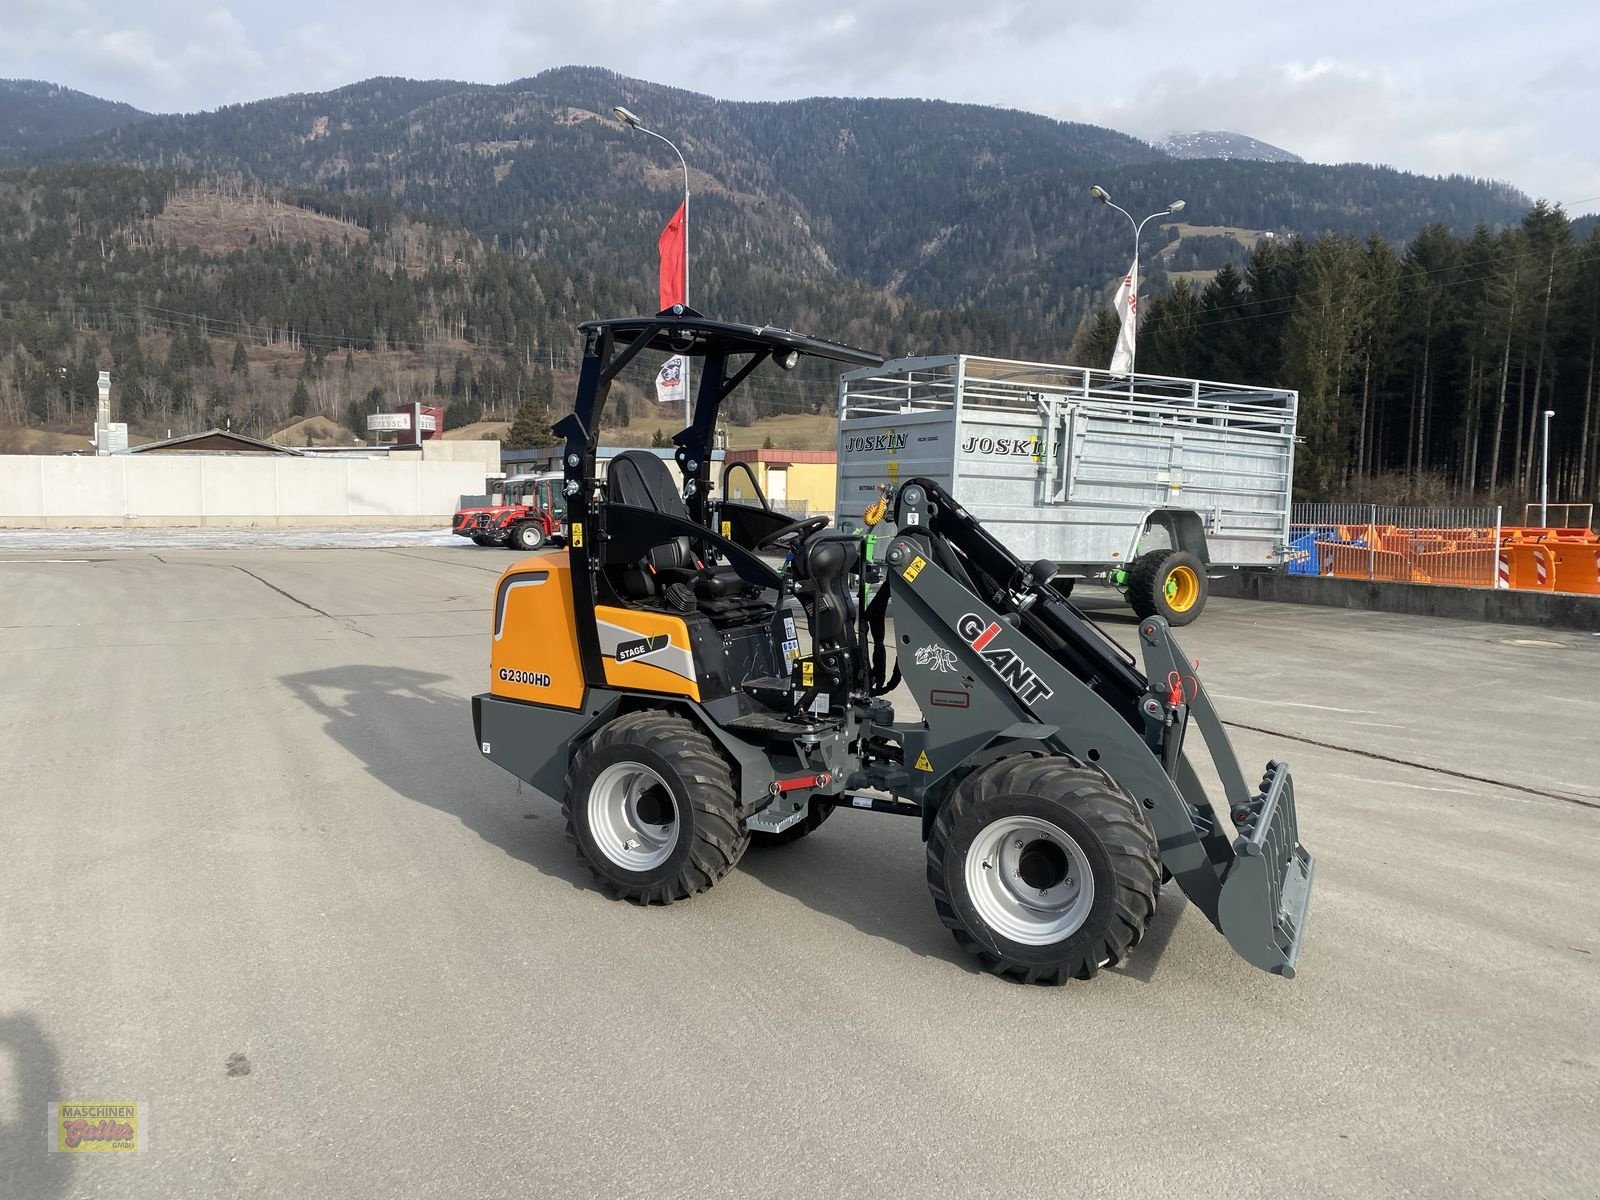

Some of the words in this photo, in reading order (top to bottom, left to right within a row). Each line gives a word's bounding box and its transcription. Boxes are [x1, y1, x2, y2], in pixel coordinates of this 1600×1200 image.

[845, 432, 908, 452] JOSKIN
[620, 645, 646, 659] STAGE
[957, 613, 1054, 706] GIANT
[498, 667, 551, 687] G2300HD
